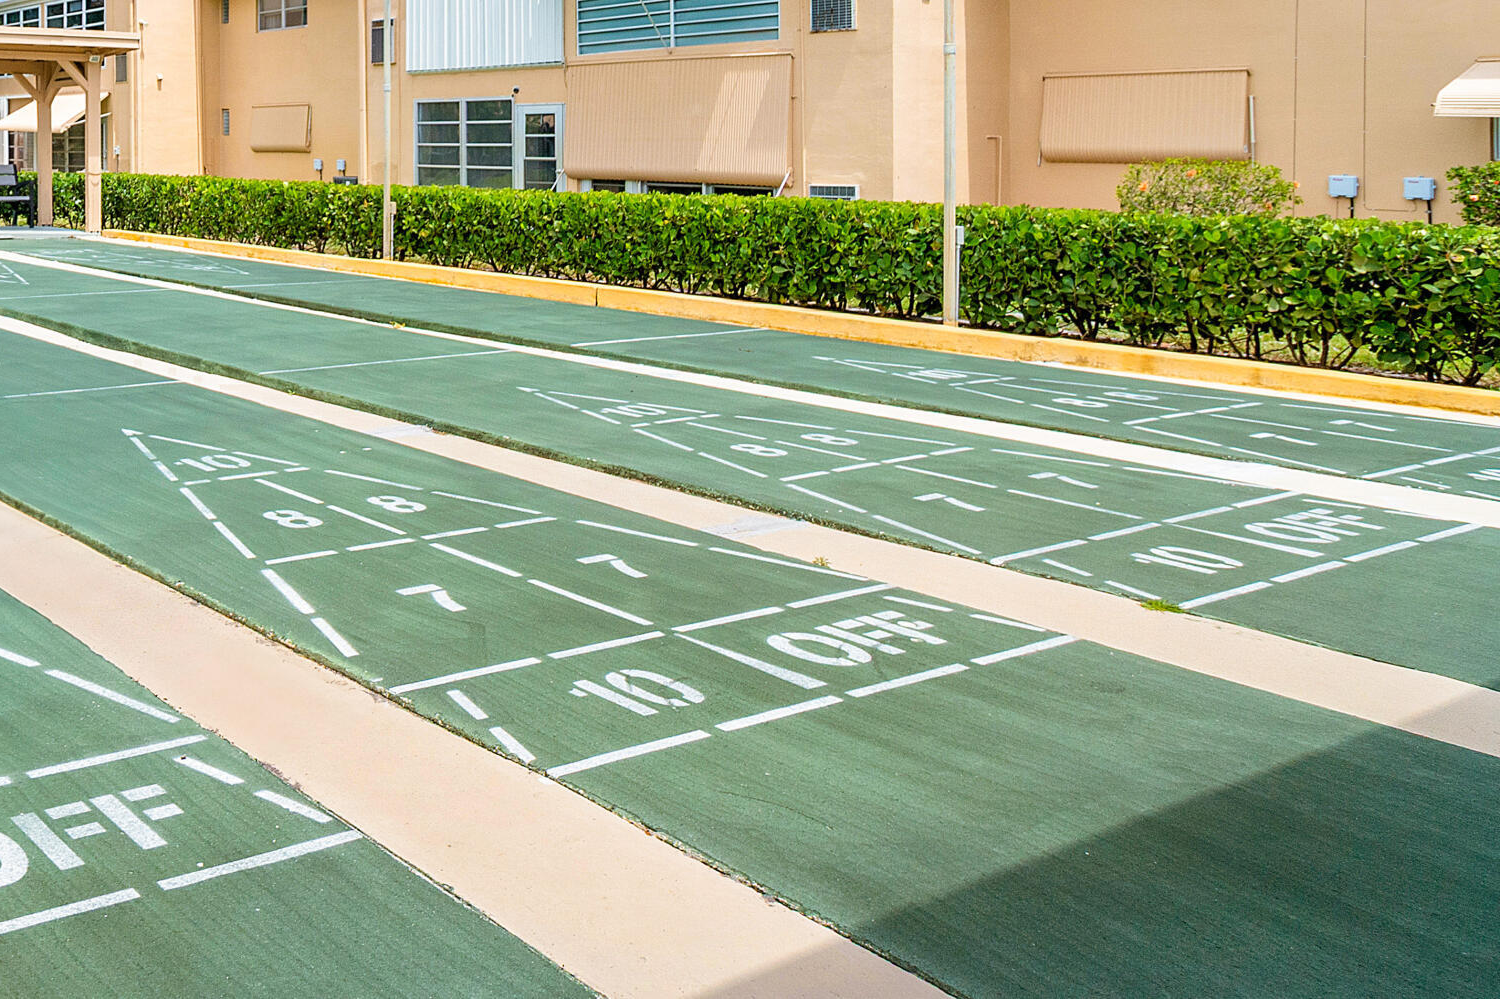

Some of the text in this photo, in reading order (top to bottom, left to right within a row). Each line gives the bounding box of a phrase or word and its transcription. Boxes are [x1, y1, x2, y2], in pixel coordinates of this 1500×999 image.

[601, 404, 668, 417] 10
[730, 432, 860, 457] 8 8
[172, 451, 252, 471] 10
[262, 495, 427, 529] 8 8
[913, 492, 987, 512] 7
[1130, 507, 1386, 575] 10 OFF
[395, 553, 649, 613] 7 7
[569, 610, 949, 717] 10 OFF
